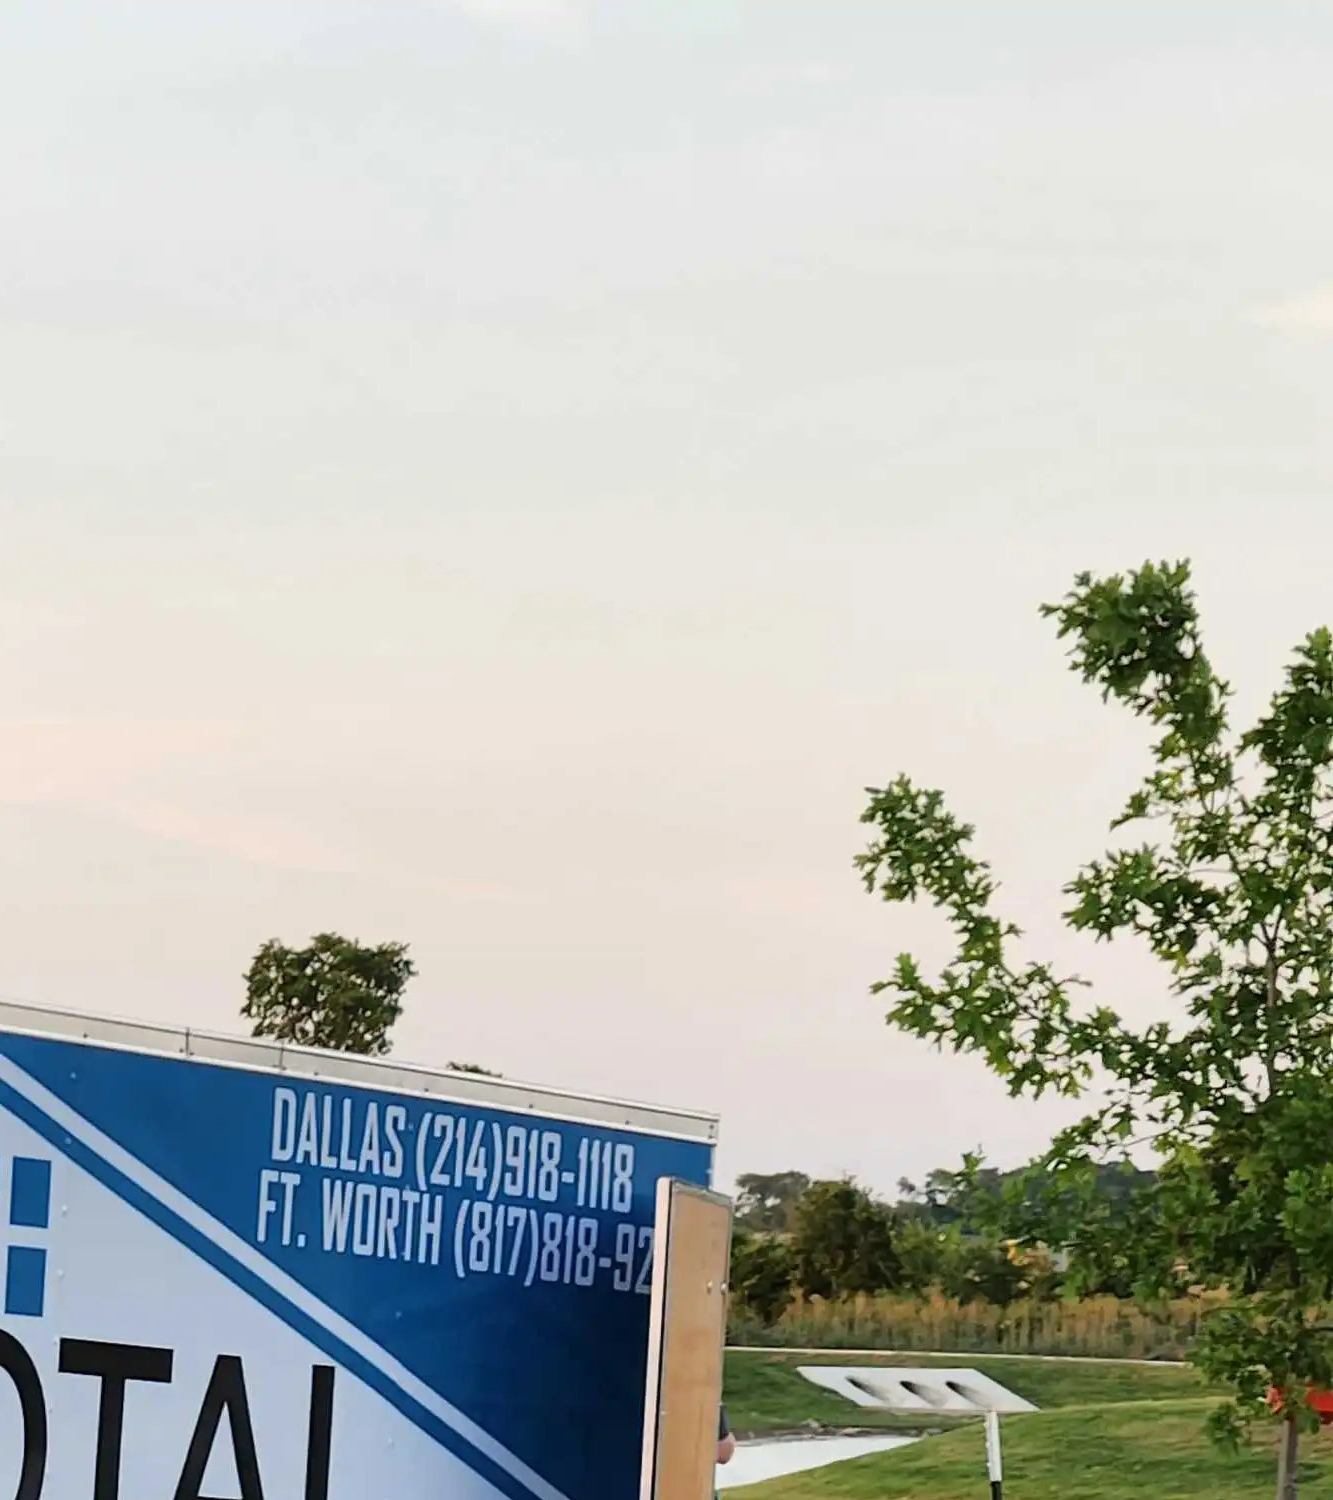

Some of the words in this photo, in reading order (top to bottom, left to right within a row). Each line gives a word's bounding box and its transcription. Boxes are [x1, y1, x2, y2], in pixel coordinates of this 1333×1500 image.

[271, 1087, 406, 1178] DALLAS
[415, 1111, 635, 1213] (214)918-1118
[256, 1169, 307, 1248] FT.
[321, 1176, 444, 1266] WORTH
[453, 1199, 654, 1294] (817)818-92
